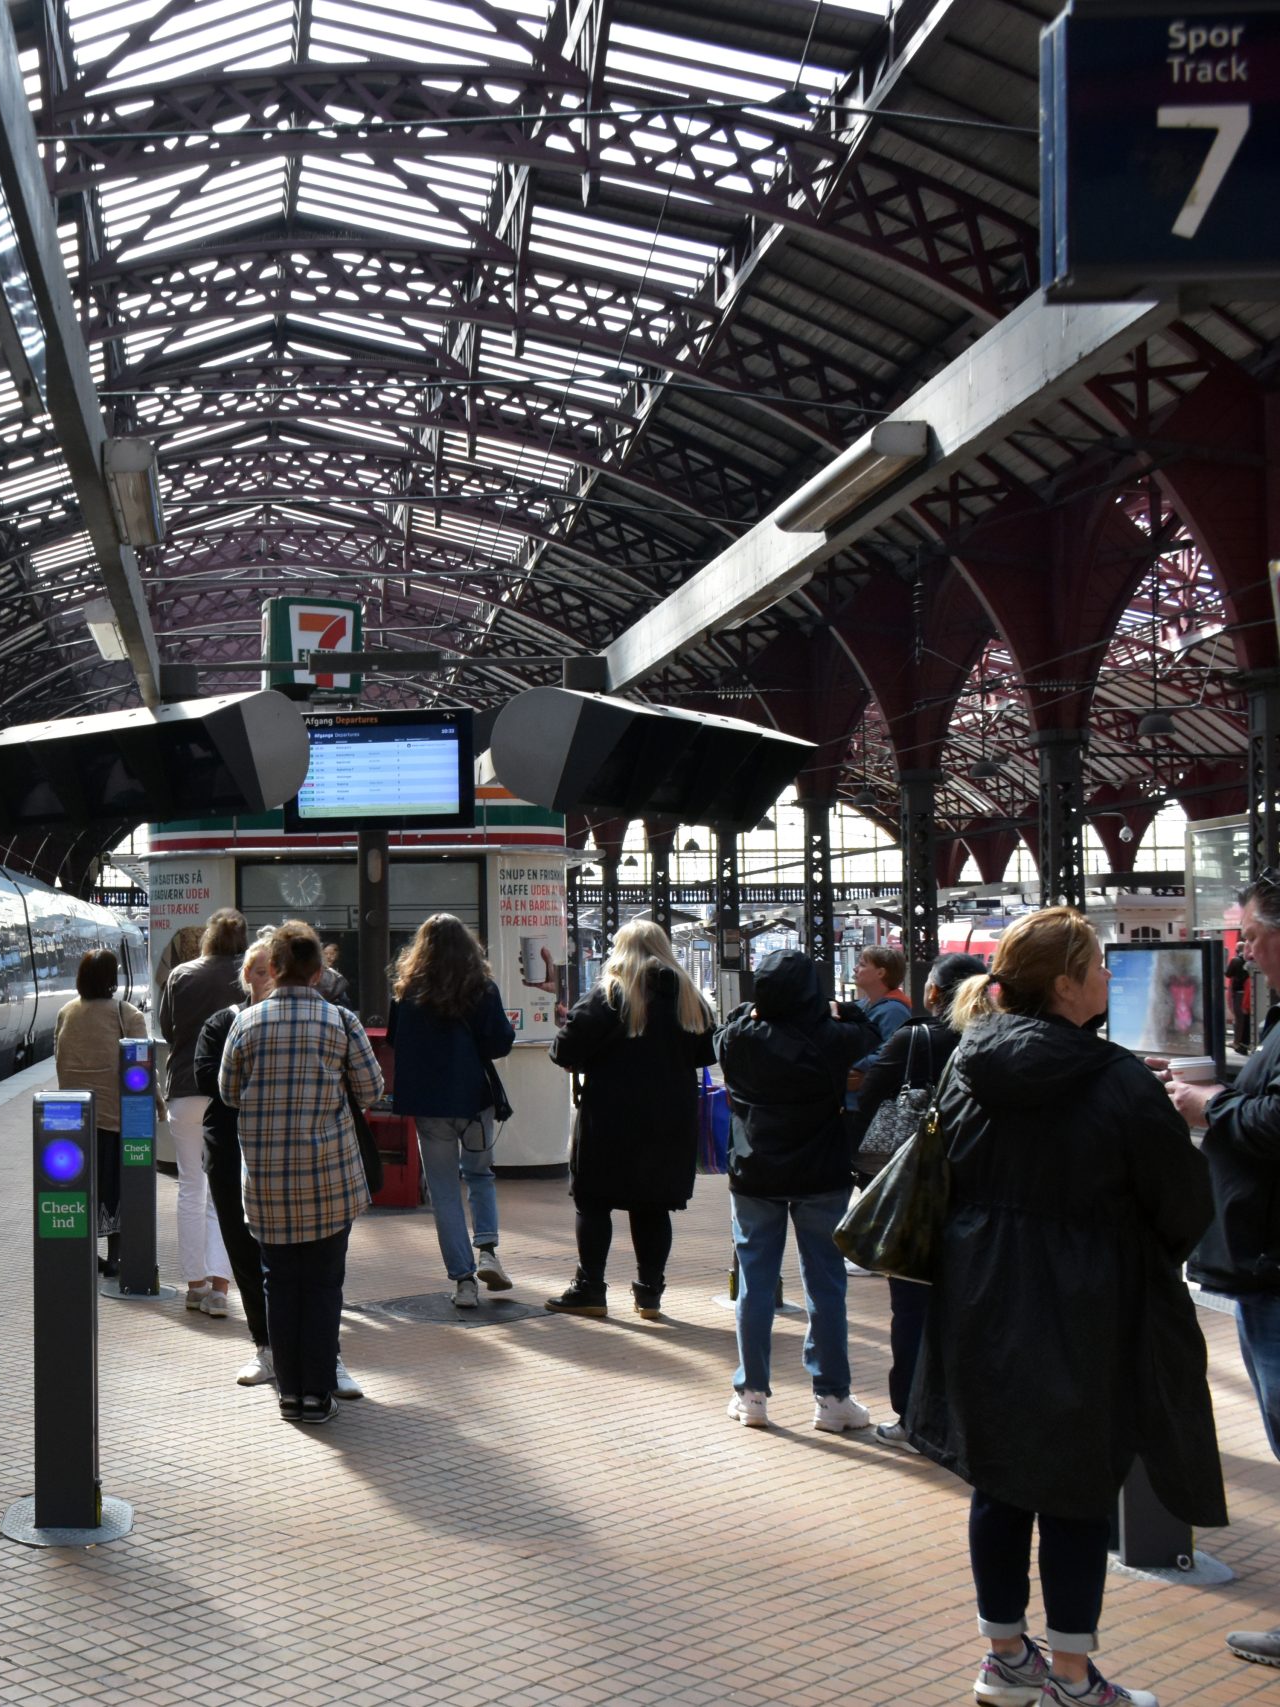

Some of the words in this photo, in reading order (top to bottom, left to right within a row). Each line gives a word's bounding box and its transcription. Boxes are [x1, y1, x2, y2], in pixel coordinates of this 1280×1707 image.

[1167, 21, 1245, 54] Spor
[1167, 54, 1248, 83] Track
[1157, 104, 1250, 239] 7
[298, 612, 346, 688] 7
[305, 717, 333, 727] Afgang
[335, 716, 378, 725] Departures
[158, 873, 190, 886] SAGTENS
[192, 869, 203, 884] FÅ
[499, 868, 525, 880] SNUP
[527, 868, 538, 880] EN
[185, 887, 210, 900] UDEN
[500, 884, 529, 896] KAFFE
[530, 884, 550, 896] UDEN
[167, 903, 200, 915] TRÆKKE
[500, 897, 512, 911] PÅ
[514, 899, 527, 911] EN
[500, 915, 538, 927] TRÆNER
[124, 1144, 151, 1153] Check
[130, 1153, 144, 1161] ind
[41, 1201, 85, 1214] Check
[52, 1216, 75, 1228] ind
